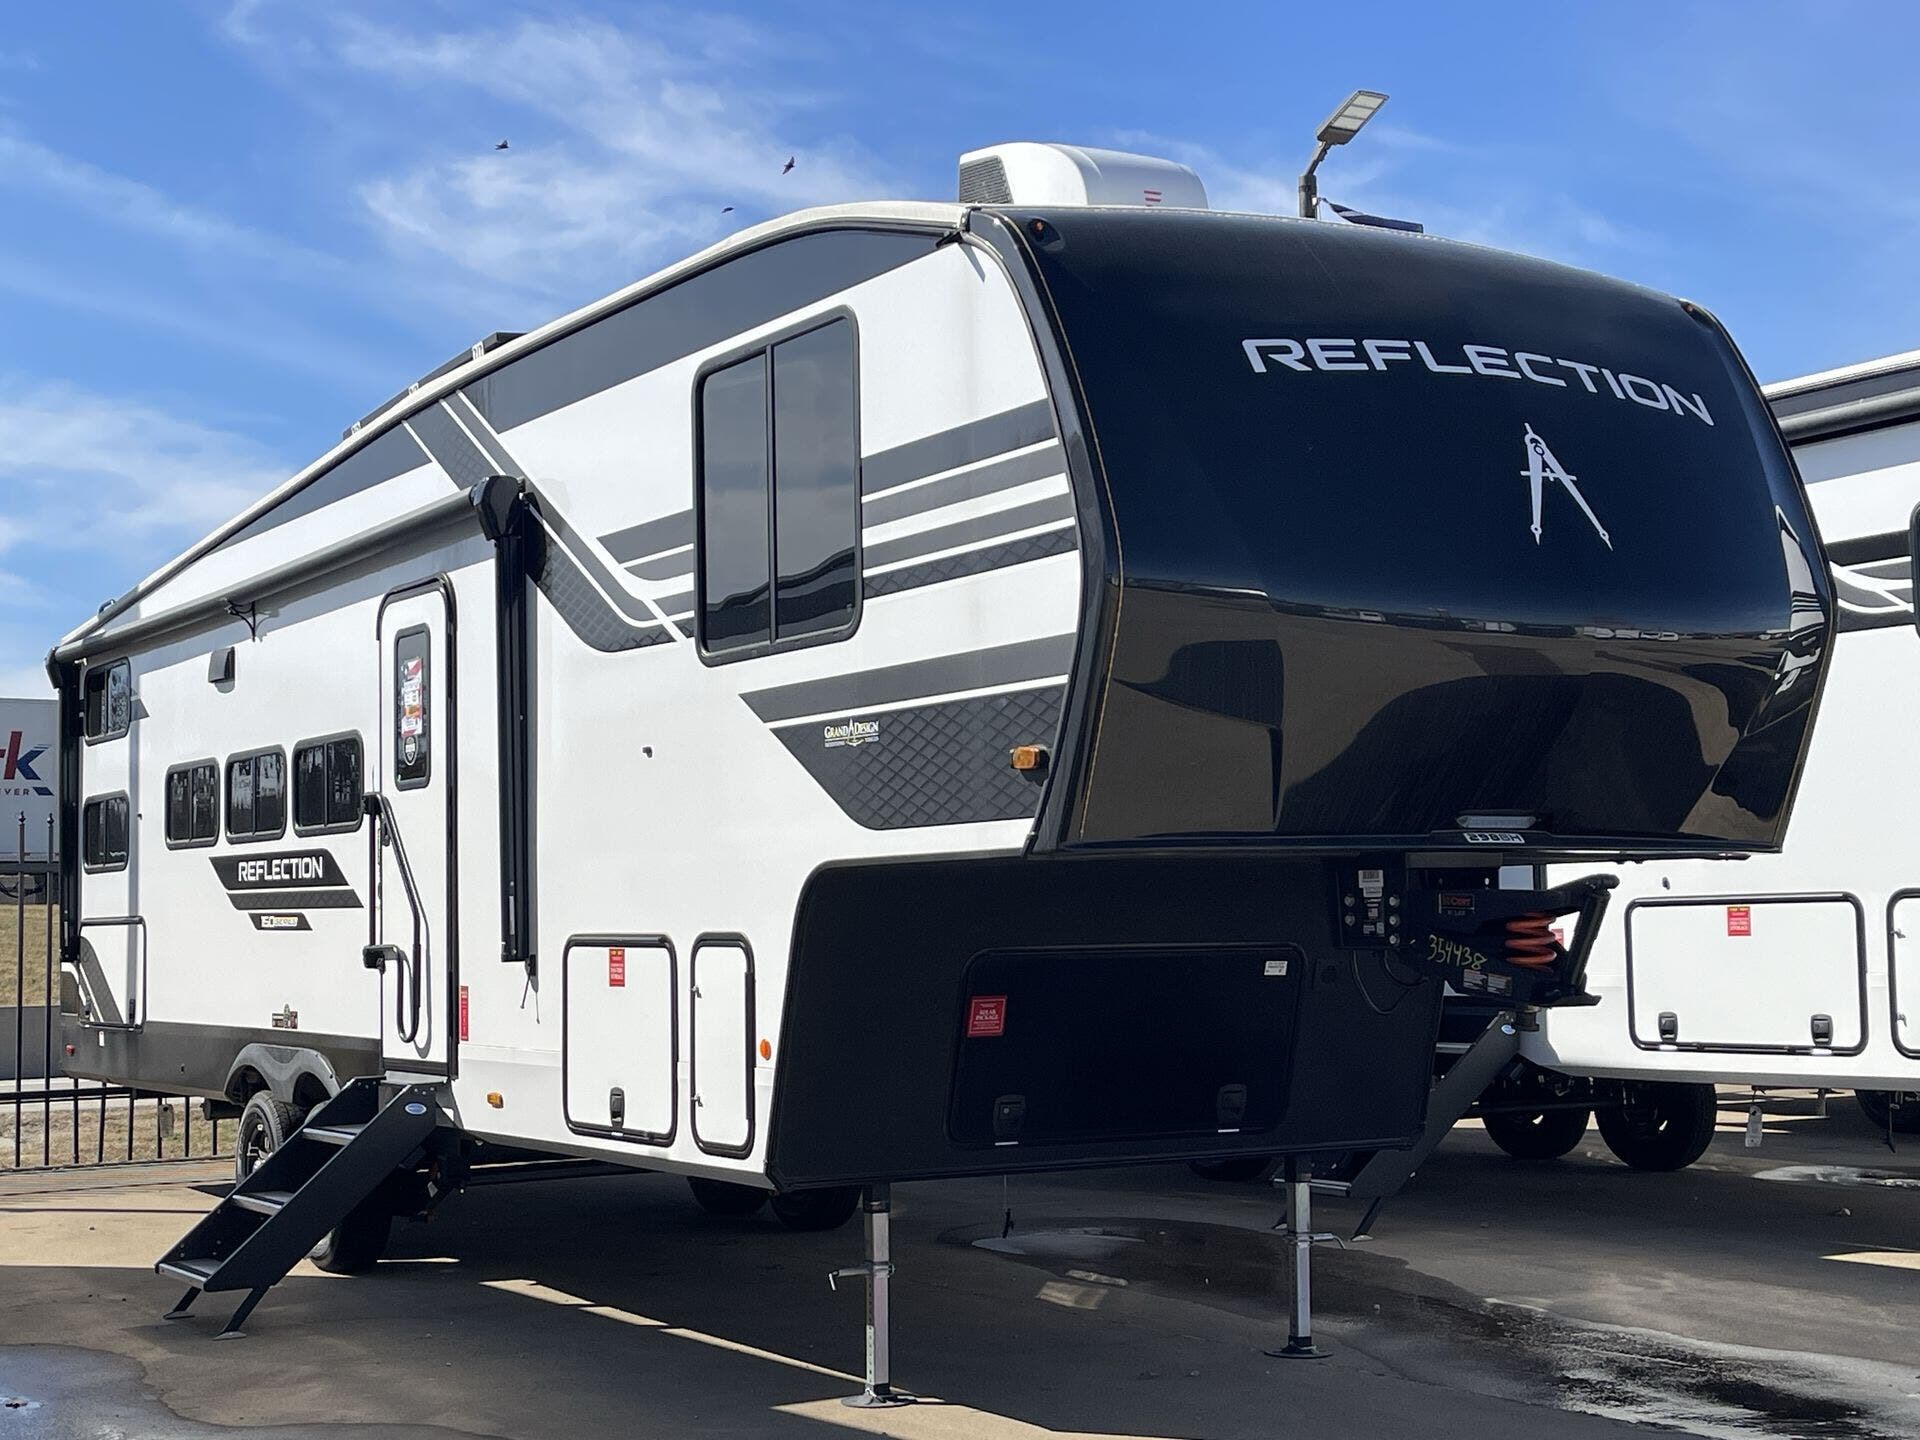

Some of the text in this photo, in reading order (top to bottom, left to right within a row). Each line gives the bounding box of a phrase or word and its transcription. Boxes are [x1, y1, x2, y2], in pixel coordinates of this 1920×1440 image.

[1242, 337, 1714, 426] REFLECTION
[238, 856, 323, 882] REFLECTION
[1427, 934, 1488, 970] 354438
